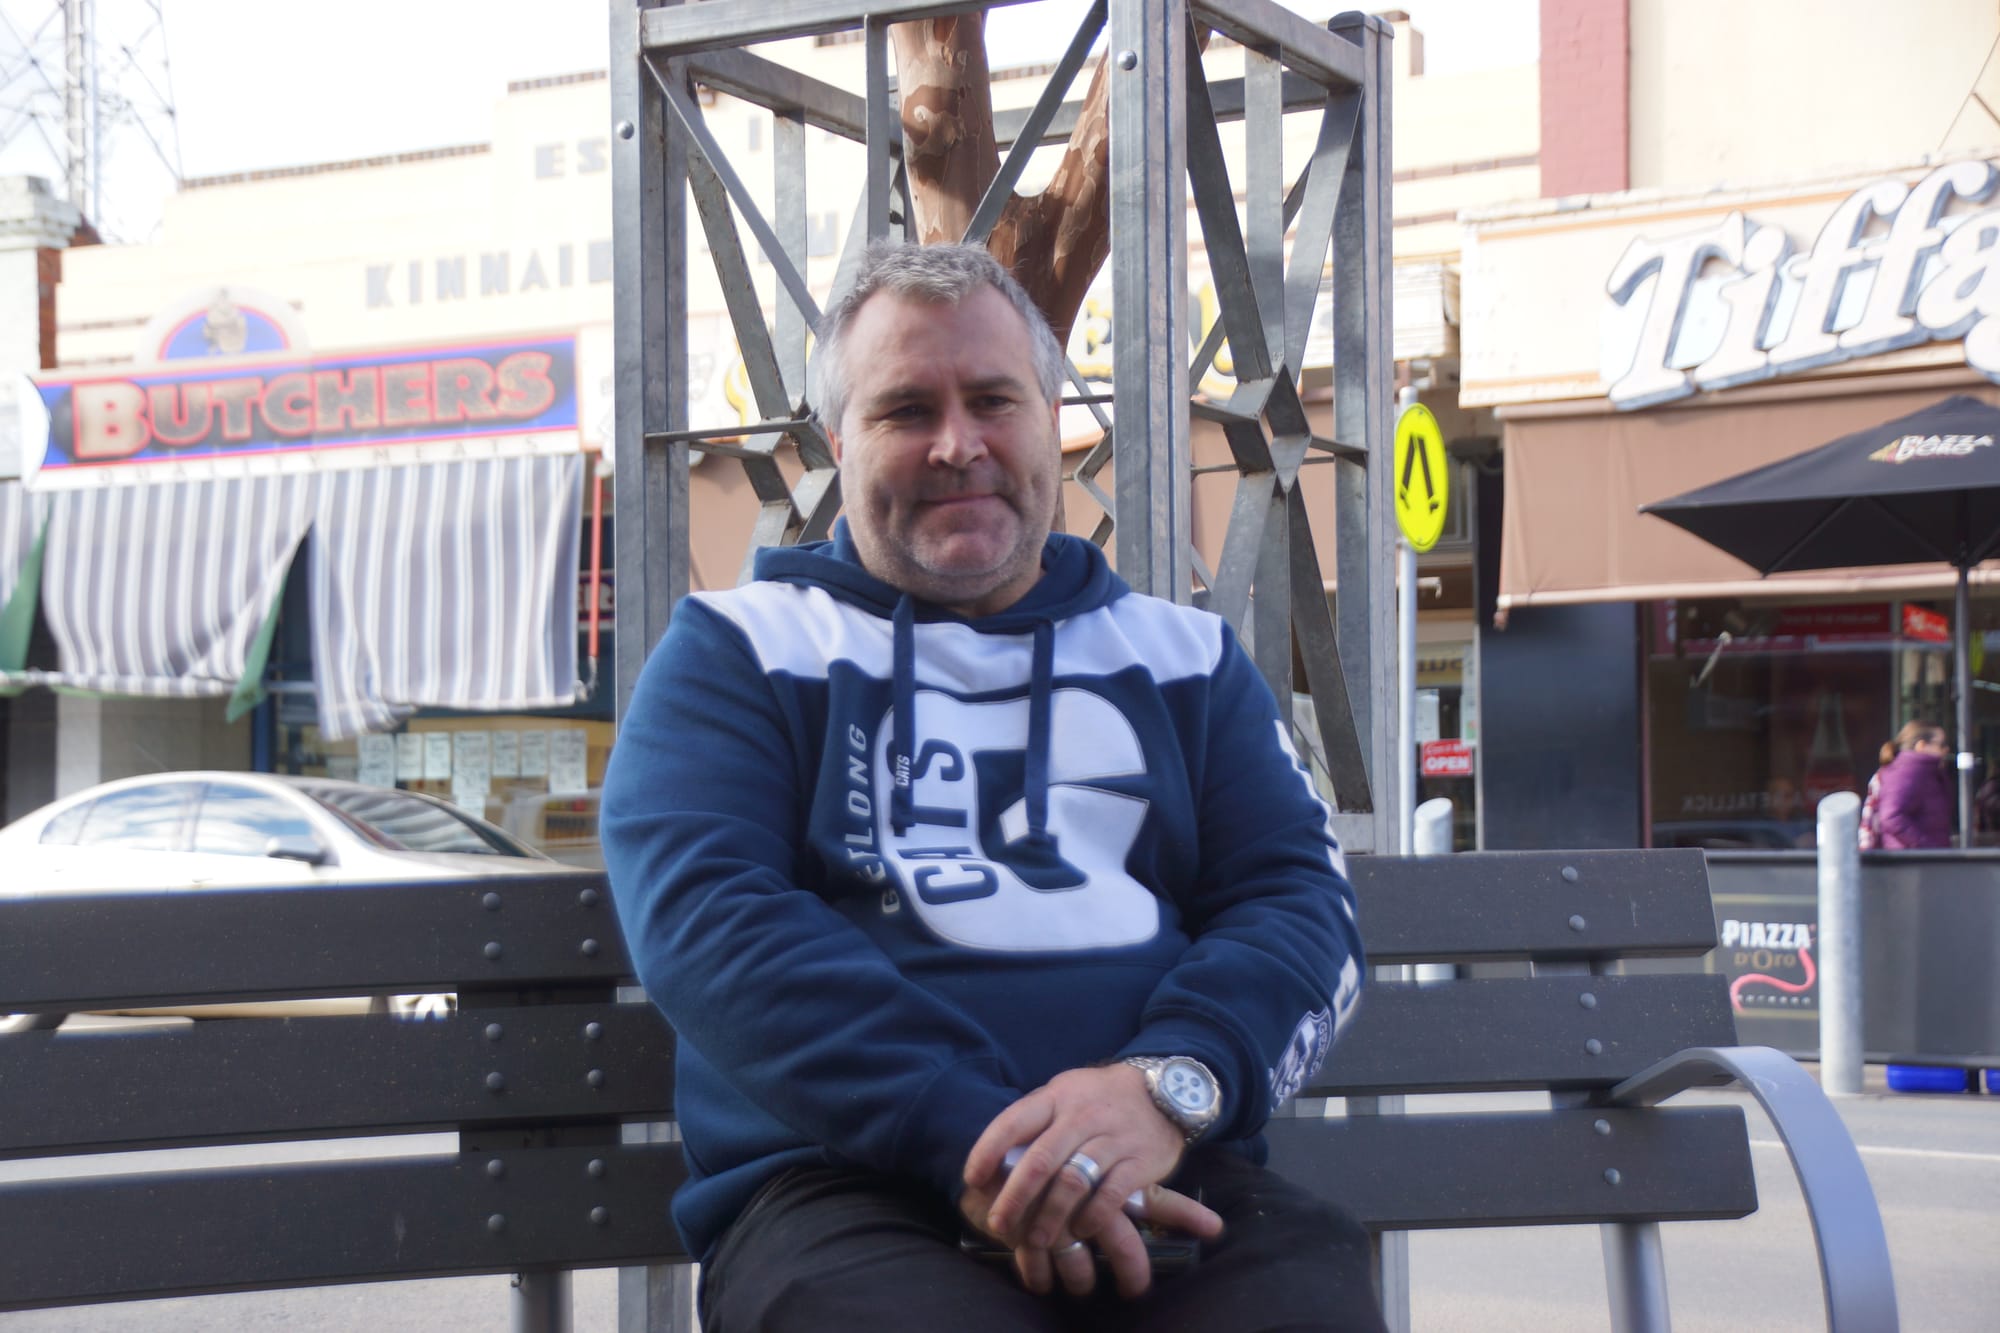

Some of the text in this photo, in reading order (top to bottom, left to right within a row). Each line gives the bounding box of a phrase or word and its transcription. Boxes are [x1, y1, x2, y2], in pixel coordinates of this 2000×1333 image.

[1605, 160, 2000, 411] Tiffa
[71, 350, 556, 461] BUTCHERS
[371, 436, 542, 465] MEATS
[894, 753, 912, 787] CATS
[1425, 756, 1470, 771] OPEN
[1720, 919, 1812, 949] PIAZZA
